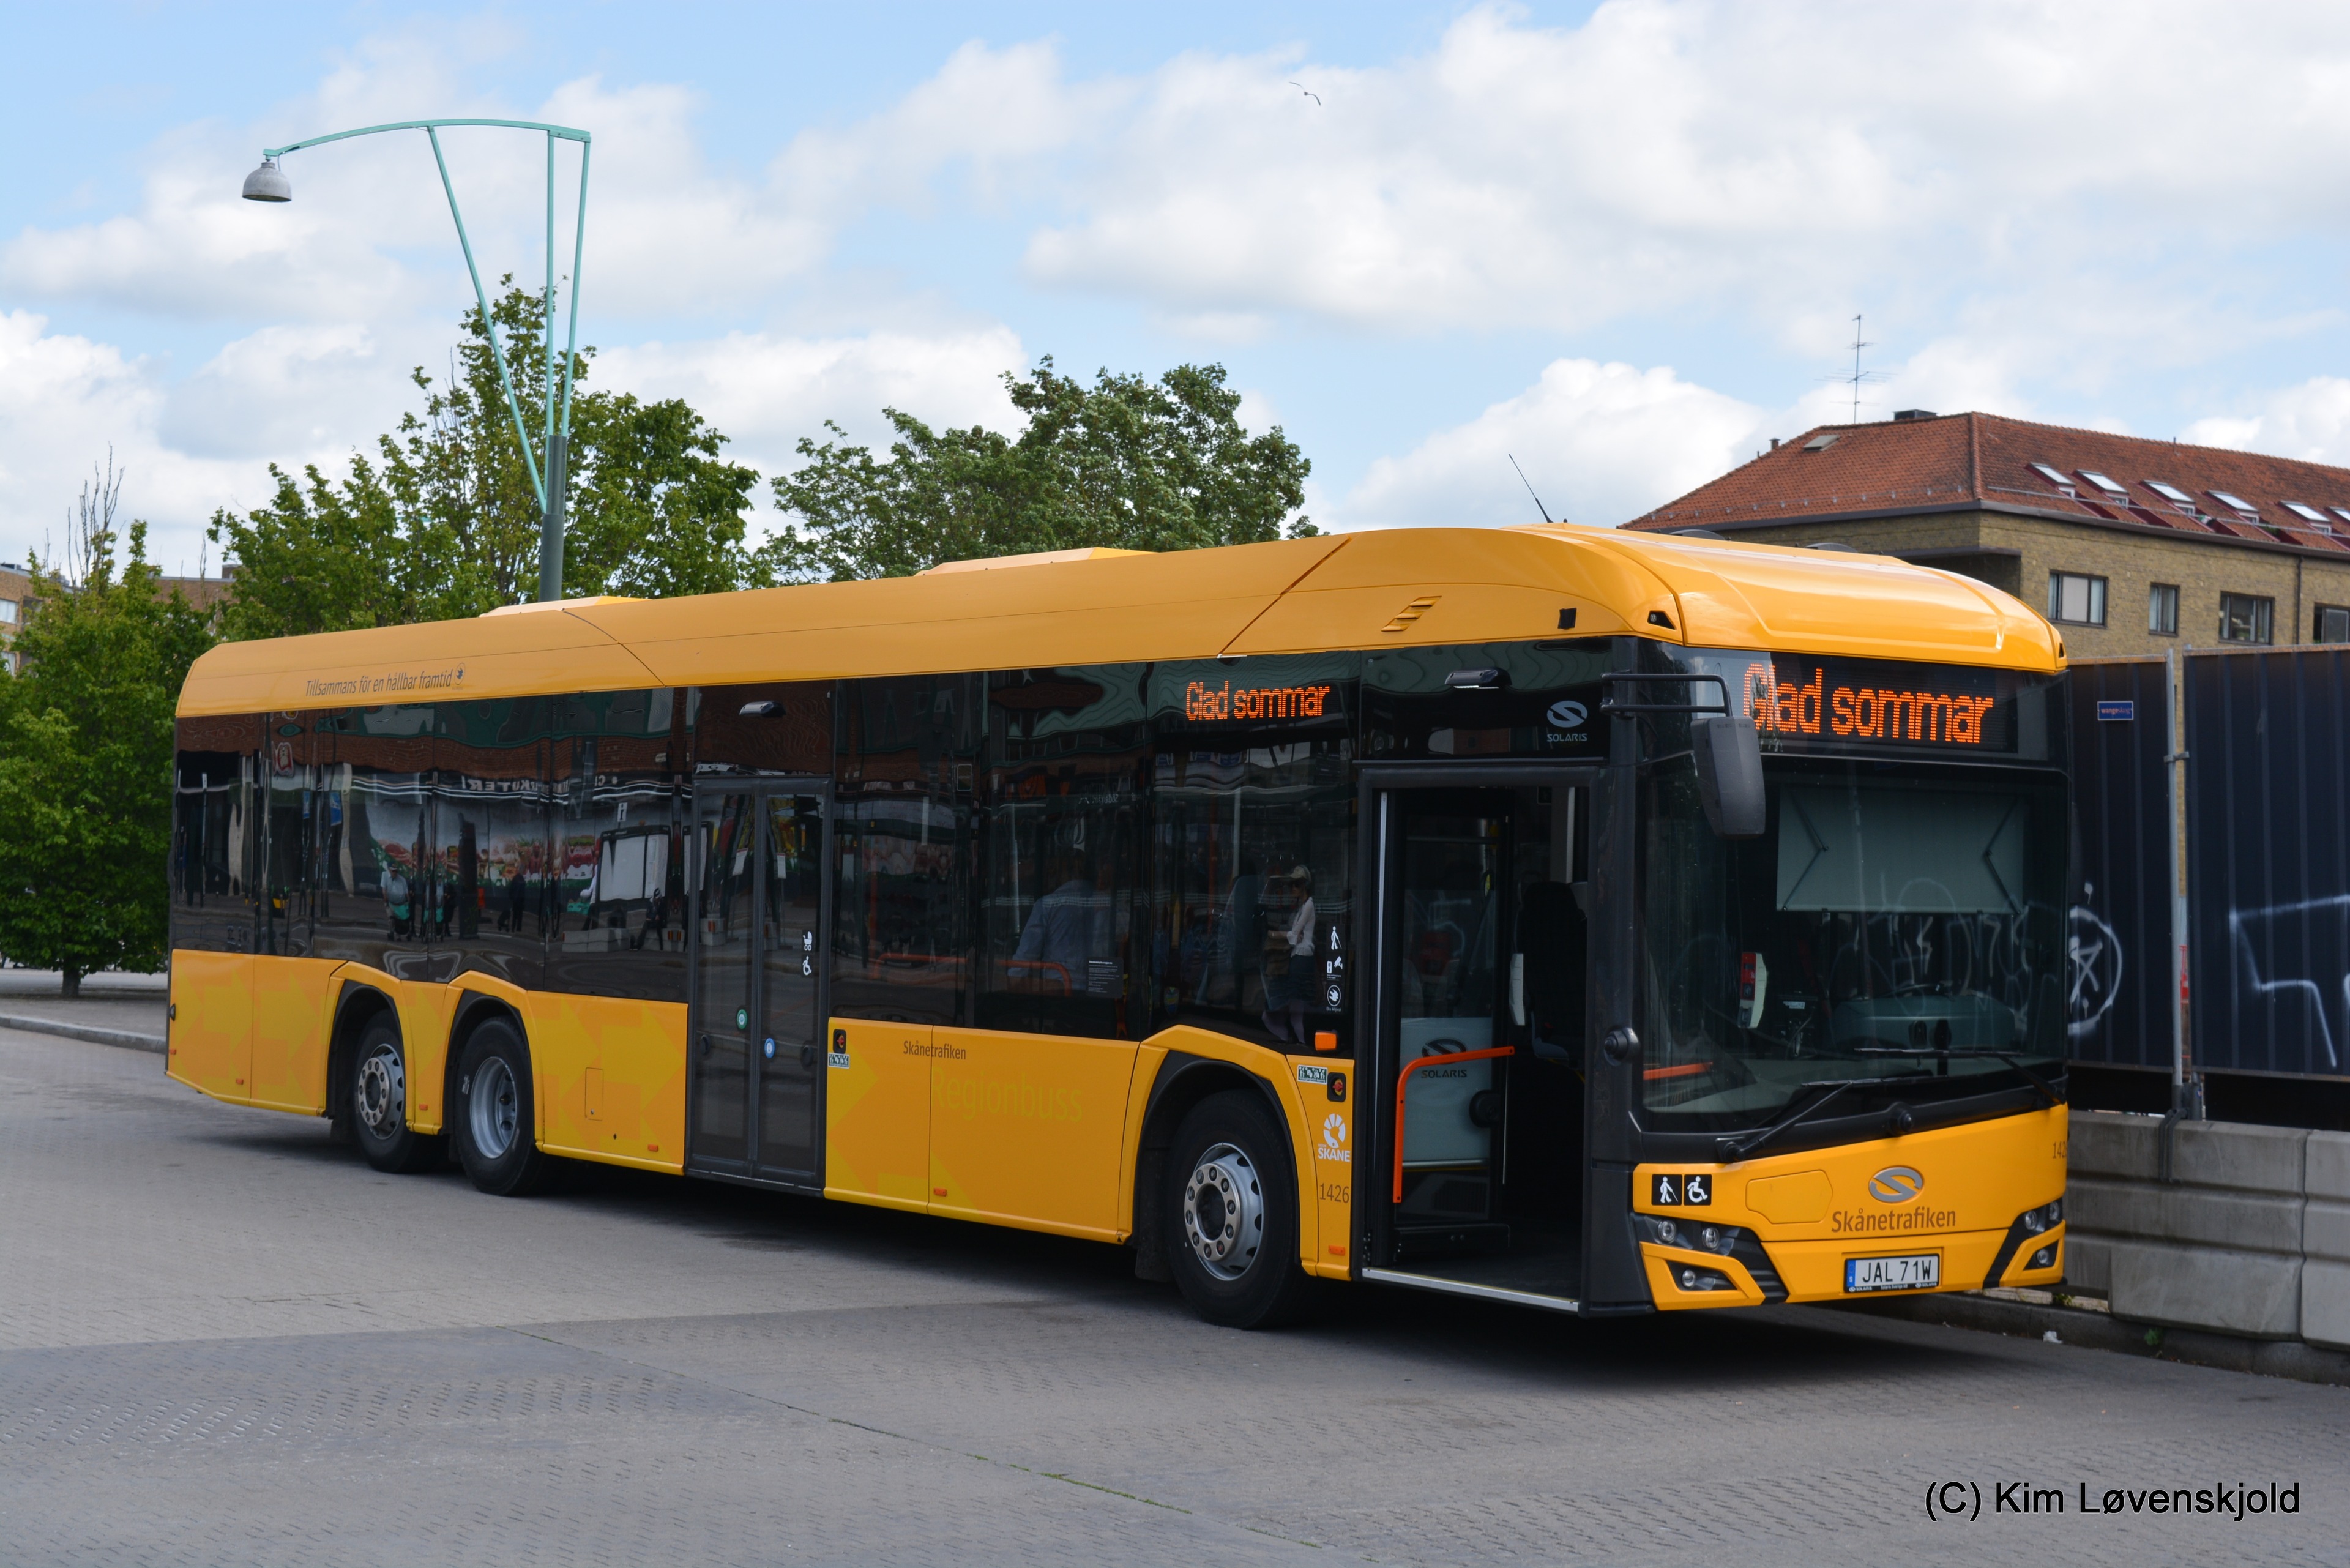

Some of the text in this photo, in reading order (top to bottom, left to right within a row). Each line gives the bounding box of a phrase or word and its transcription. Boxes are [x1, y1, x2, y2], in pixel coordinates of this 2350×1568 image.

[305, 669, 453, 696] Tillsammans för en hållbar framtid
[1185, 681, 1330, 720] Glad sommar
[1743, 663, 1994, 744] Glad sommar
[1546, 733, 1588, 743] SOLARIS
[903, 1040, 966, 1060] Skånetrafiken
[1420, 1069, 1468, 1080] SOLARIS
[931, 1066, 1083, 1122] Regionbuss
[1319, 1182, 1350, 1204] 1426
[1831, 1206, 1956, 1233] Skånetrafiken
[1862, 1260, 1931, 1283] JAL 71W
